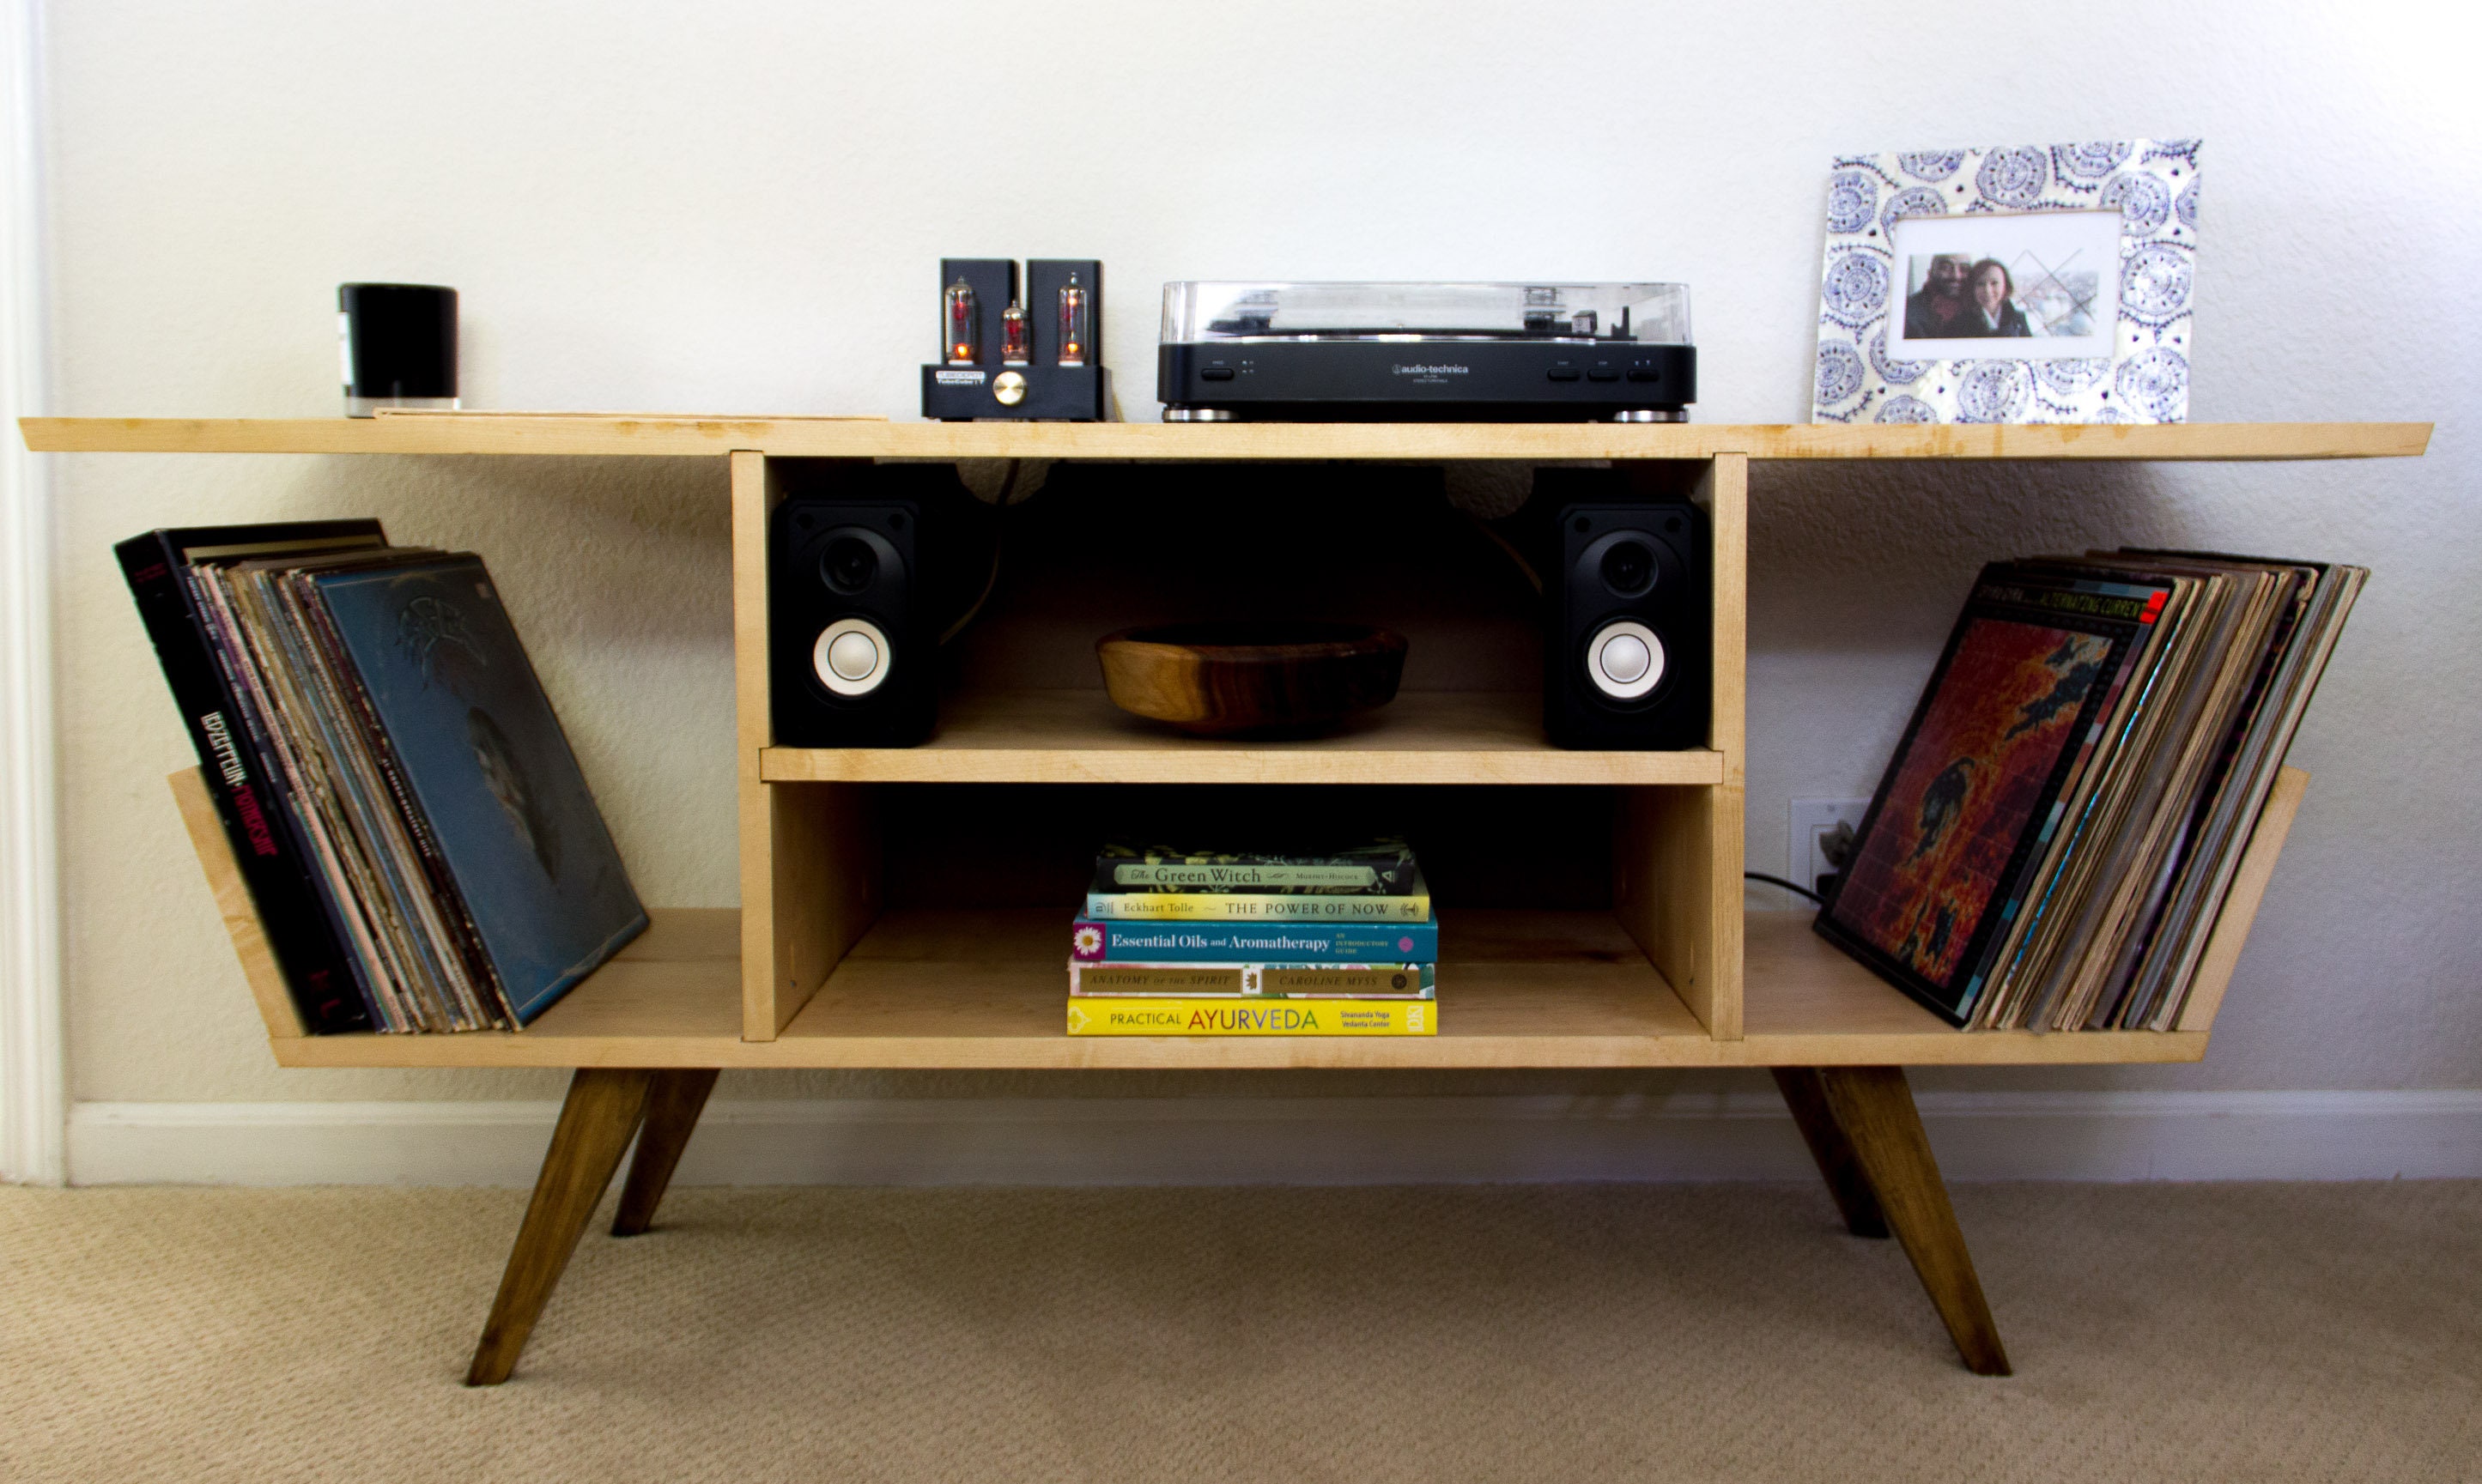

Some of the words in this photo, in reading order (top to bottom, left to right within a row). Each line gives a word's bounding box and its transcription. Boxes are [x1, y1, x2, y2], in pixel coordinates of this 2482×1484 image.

[1401, 364, 1469, 373] audio-technica
[1131, 869, 1150, 880] The
[1155, 868, 1206, 882] Green
[1211, 868, 1261, 882] Witch
[1124, 903, 1163, 912] Eckhart
[1168, 903, 1193, 912] Tolle
[1225, 903, 1257, 913] THE
[1265, 903, 1320, 914] POWER
[1325, 903, 1345, 915] OF
[1352, 904, 1389, 915] NOW
[1112, 934, 1175, 948] Essential
[1179, 934, 1207, 948] Oils
[1210, 938, 1226, 947] and
[1229, 935, 1331, 952] Aromatherapy
[1089, 974, 1150, 985] ANATOMY
[1190, 975, 1231, 985] SPIRIT
[1279, 975, 1341, 986] CAROLINE
[1346, 976, 1379, 986] MYSS
[1110, 1013, 1182, 1025] PRACTICAL
[1187, 1009, 1319, 1030] AYURVEDA
[1375, 1011, 1390, 1020] Yoga
[1369, 1020, 1390, 1028] Center
